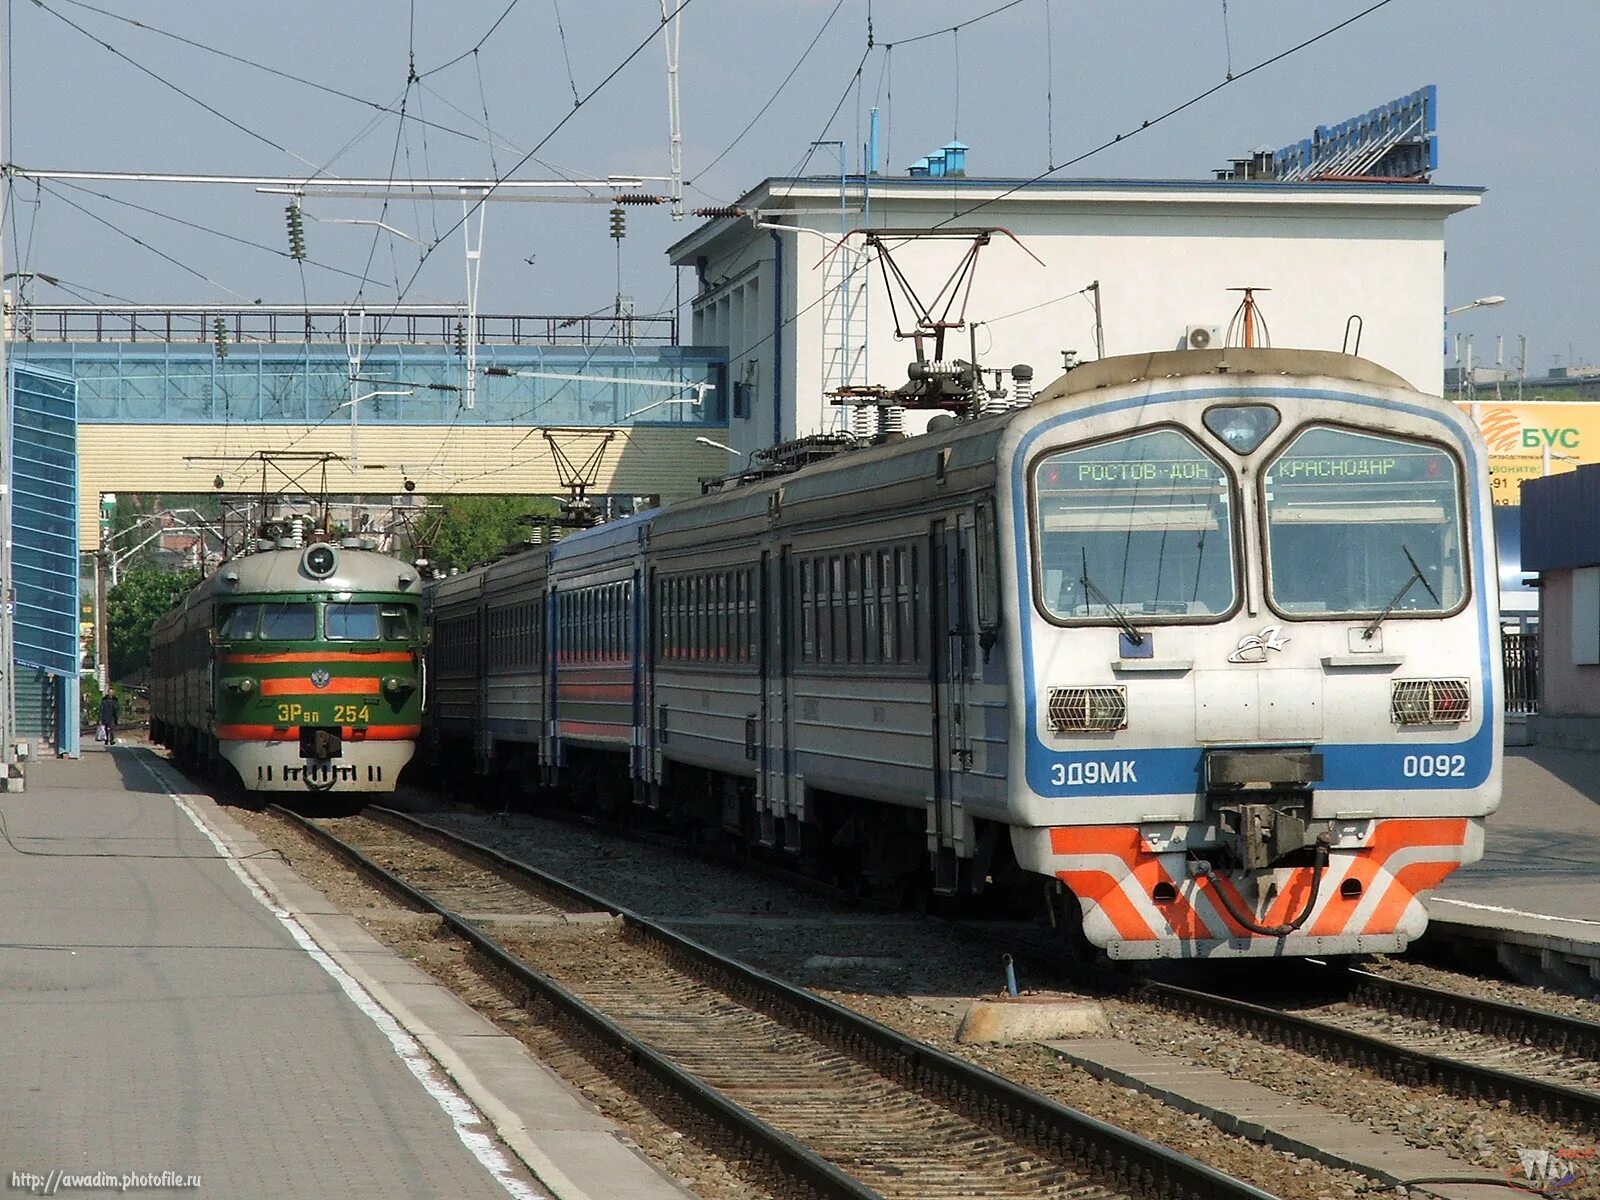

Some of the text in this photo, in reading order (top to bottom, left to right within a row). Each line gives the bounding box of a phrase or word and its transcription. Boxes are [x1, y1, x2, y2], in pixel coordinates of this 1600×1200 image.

[1522, 428, 1580, 449] БУС
[1279, 459, 1395, 477] КРАСНОДАР
[334, 705, 369, 722] 254
[1051, 761, 1138, 786] ЭД9МК
[1403, 755, 1466, 777] 0092
